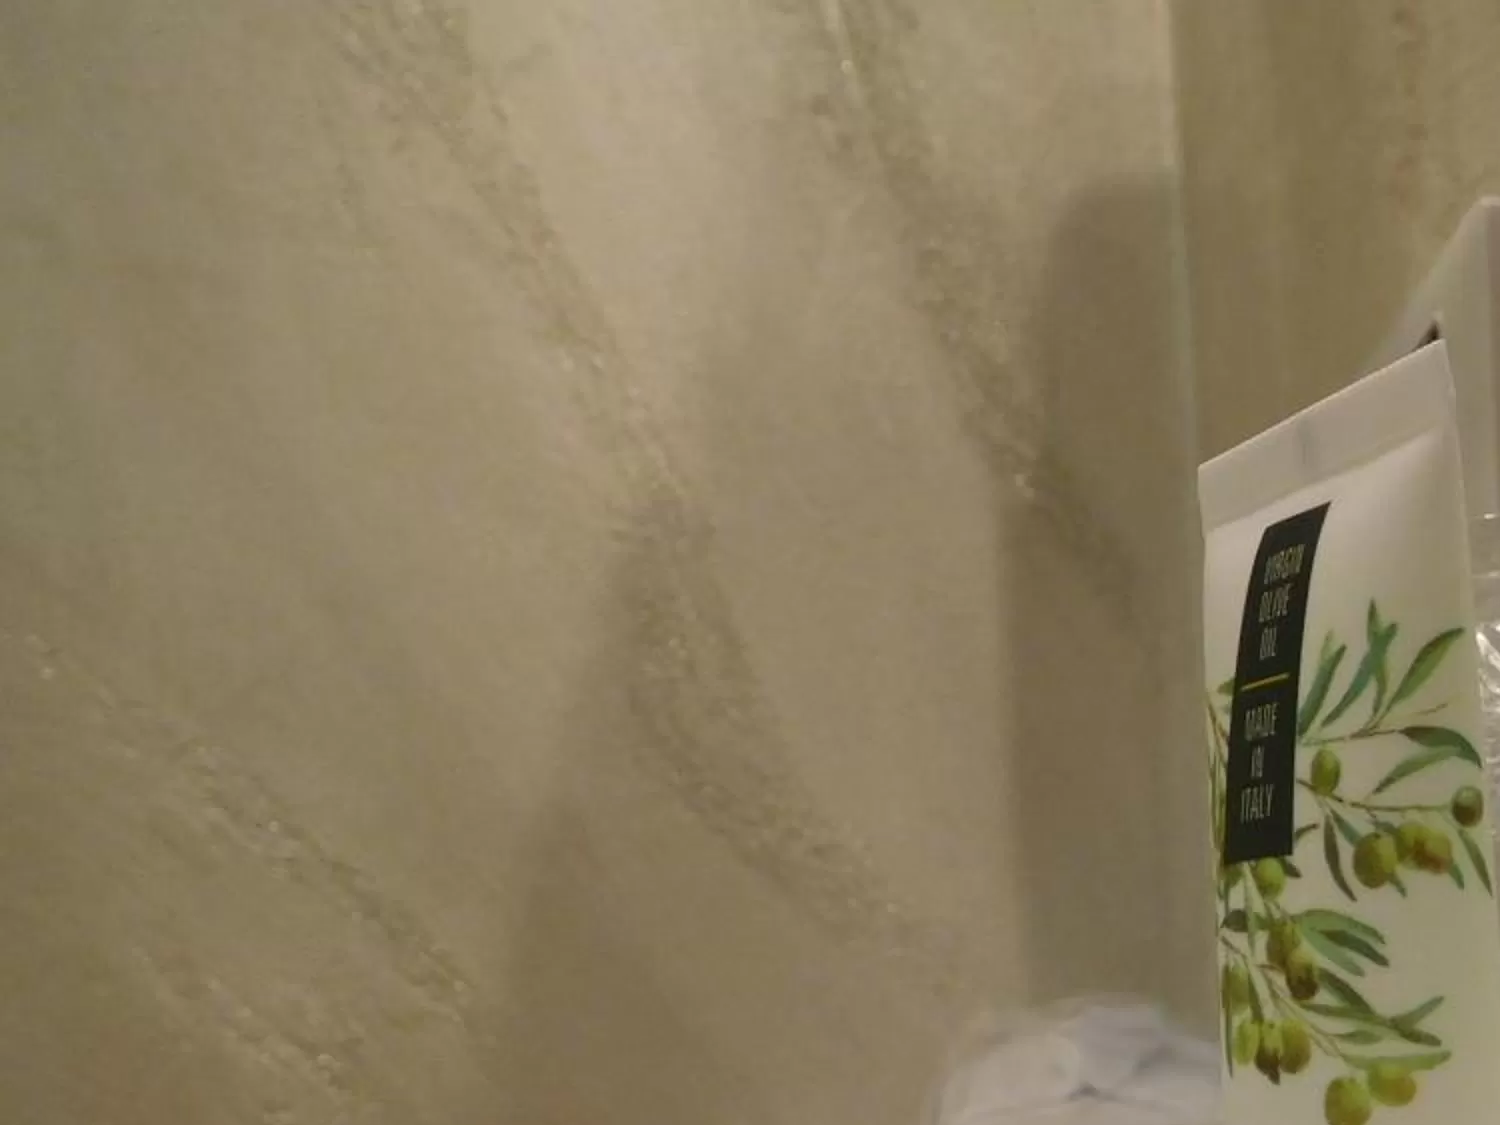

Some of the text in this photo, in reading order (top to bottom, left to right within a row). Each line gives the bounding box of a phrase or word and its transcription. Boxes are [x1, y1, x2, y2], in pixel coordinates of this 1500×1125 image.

[1258, 583, 1293, 623] OLIVE
[1259, 627, 1278, 661] OIL
[1245, 702, 1280, 742] MADE
[1251, 745, 1265, 779] IN
[1240, 783, 1275, 825] ITALY
